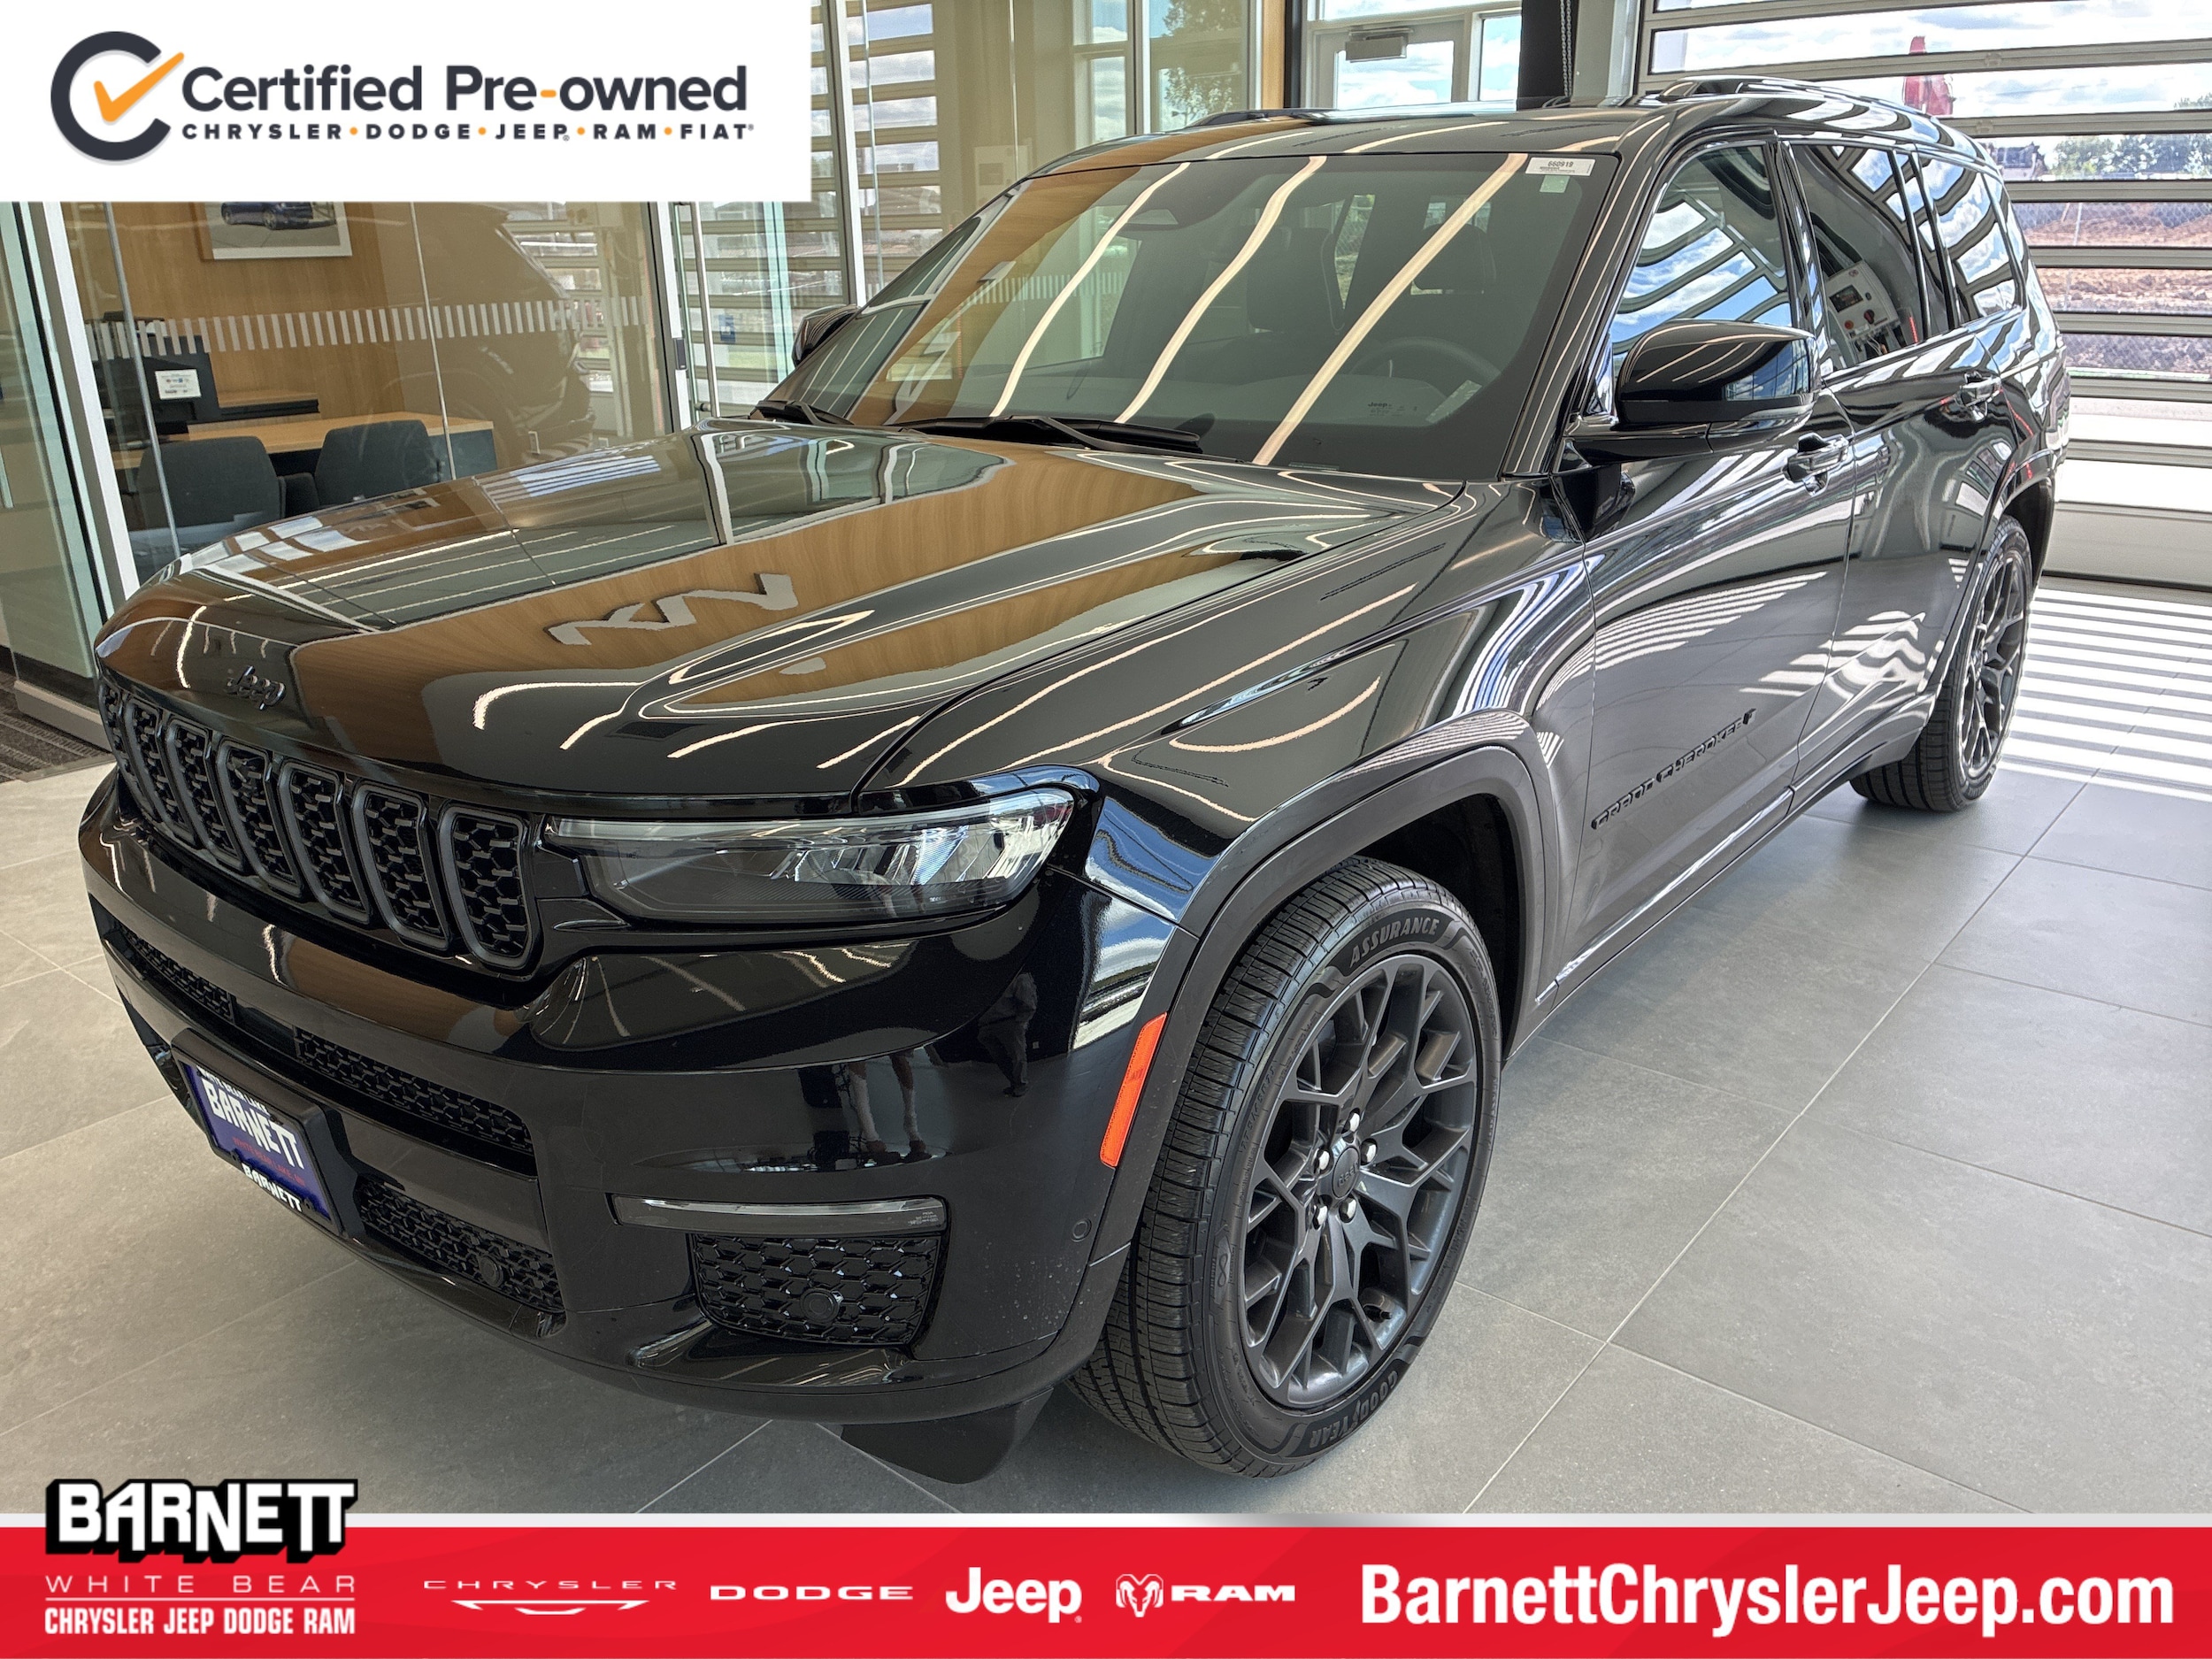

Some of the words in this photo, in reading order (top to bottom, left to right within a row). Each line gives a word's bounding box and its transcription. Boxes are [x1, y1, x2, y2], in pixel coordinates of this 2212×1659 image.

[227, 665, 286, 710] Jeep
[1349, 917, 1440, 969] ASSURANCE
[201, 1076, 305, 1170] BARNETT
[241, 1162, 303, 1213] BARNETT
[1309, 1370, 1399, 1448] GOODYEAR
